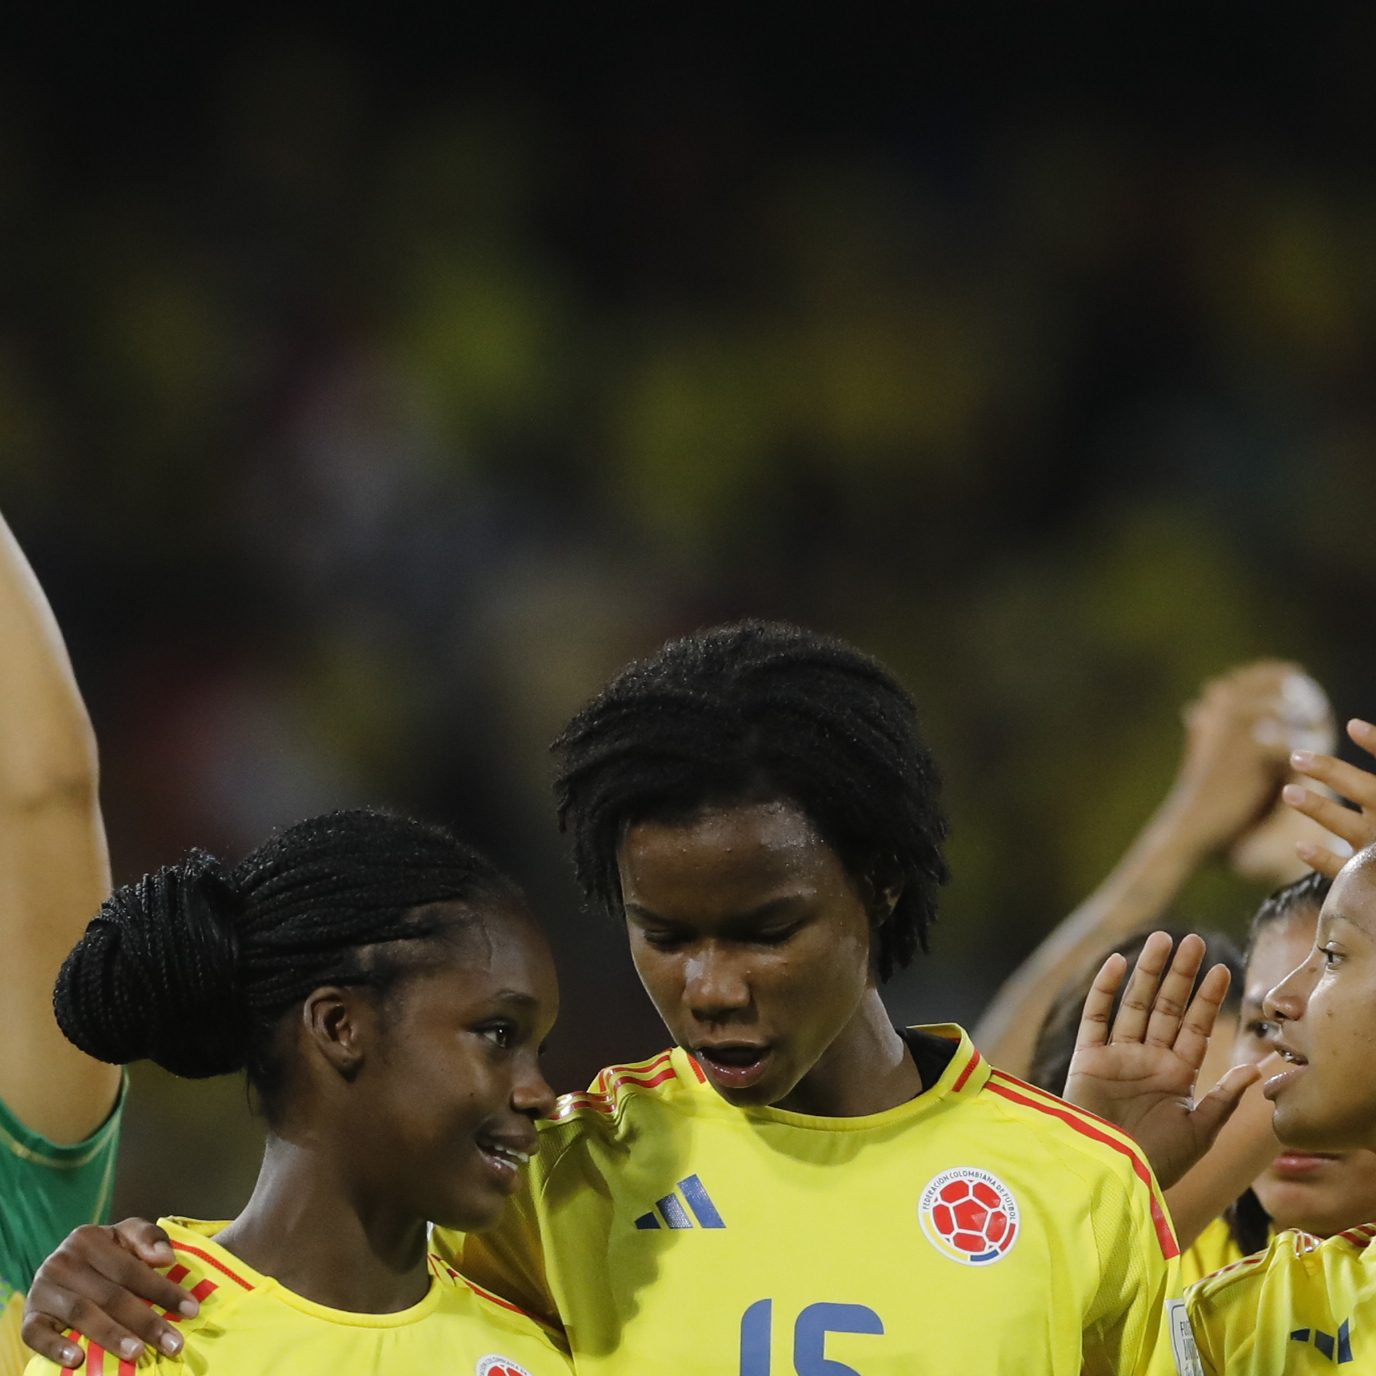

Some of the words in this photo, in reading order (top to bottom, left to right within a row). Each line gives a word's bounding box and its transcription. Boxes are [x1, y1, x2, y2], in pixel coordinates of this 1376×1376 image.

[922, 1175, 950, 1210] FEDERACION
[949, 1170, 997, 1187] COLOMBIANA
[995, 1185, 1006, 1195] DE
[1002, 1193, 1016, 1220] FUTBOL
